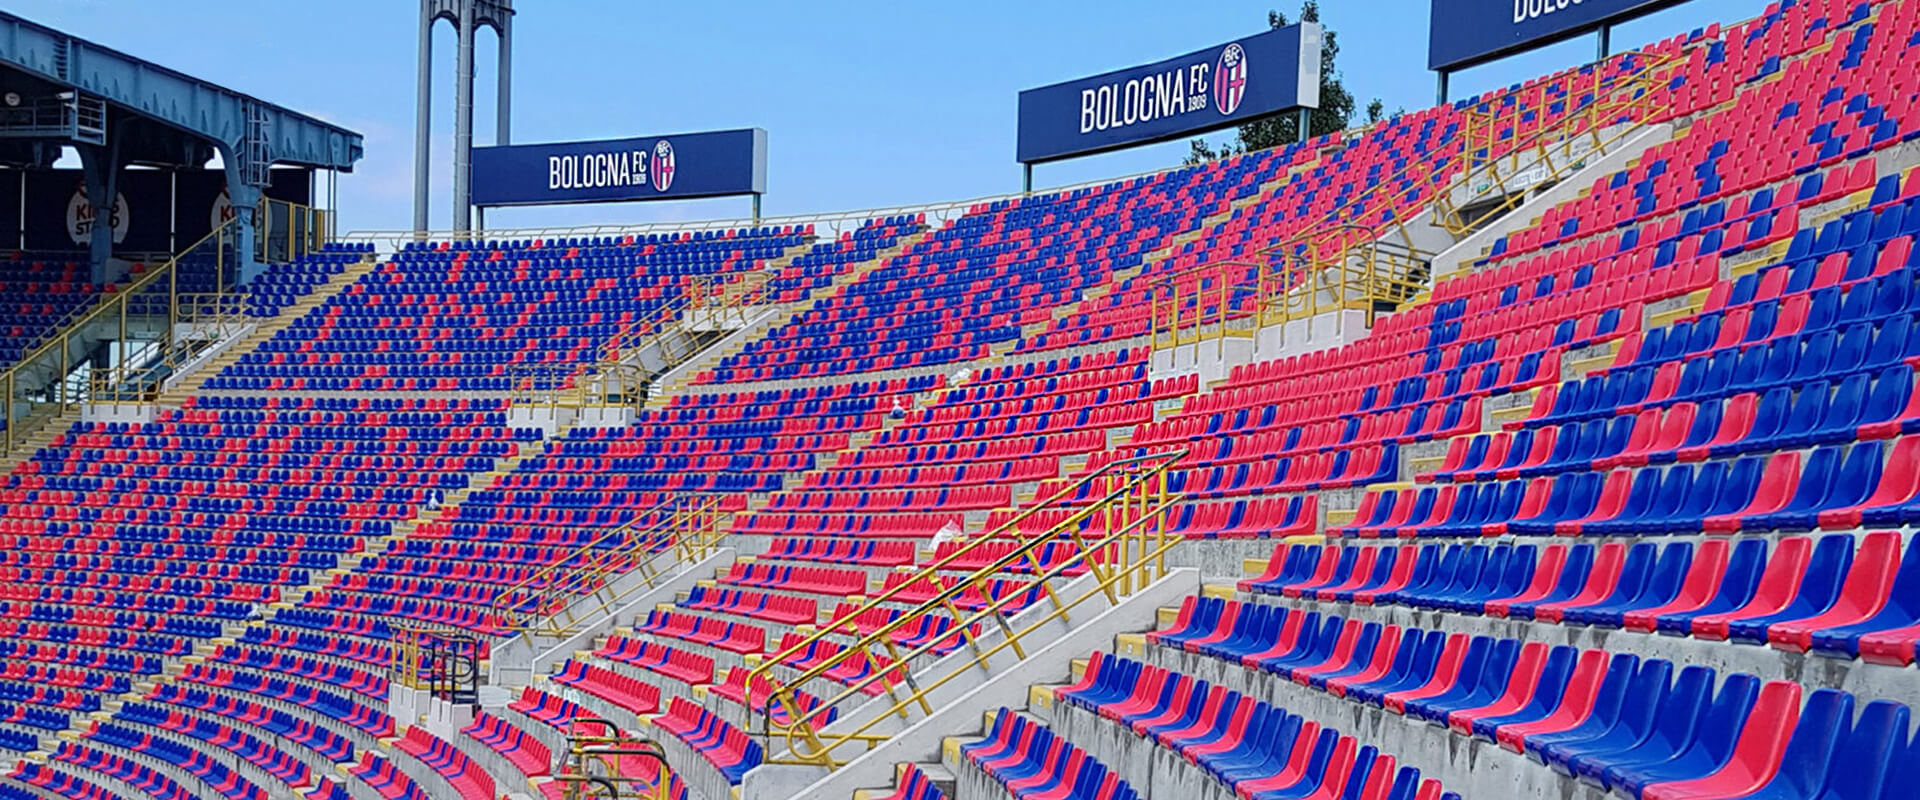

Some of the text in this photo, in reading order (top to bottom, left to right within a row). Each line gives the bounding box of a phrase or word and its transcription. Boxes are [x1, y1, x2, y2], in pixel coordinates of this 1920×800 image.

[1080, 63, 1208, 133] BOLOGNA FC
[549, 152, 630, 189] BOLOGNA
[633, 151, 647, 173] FC
